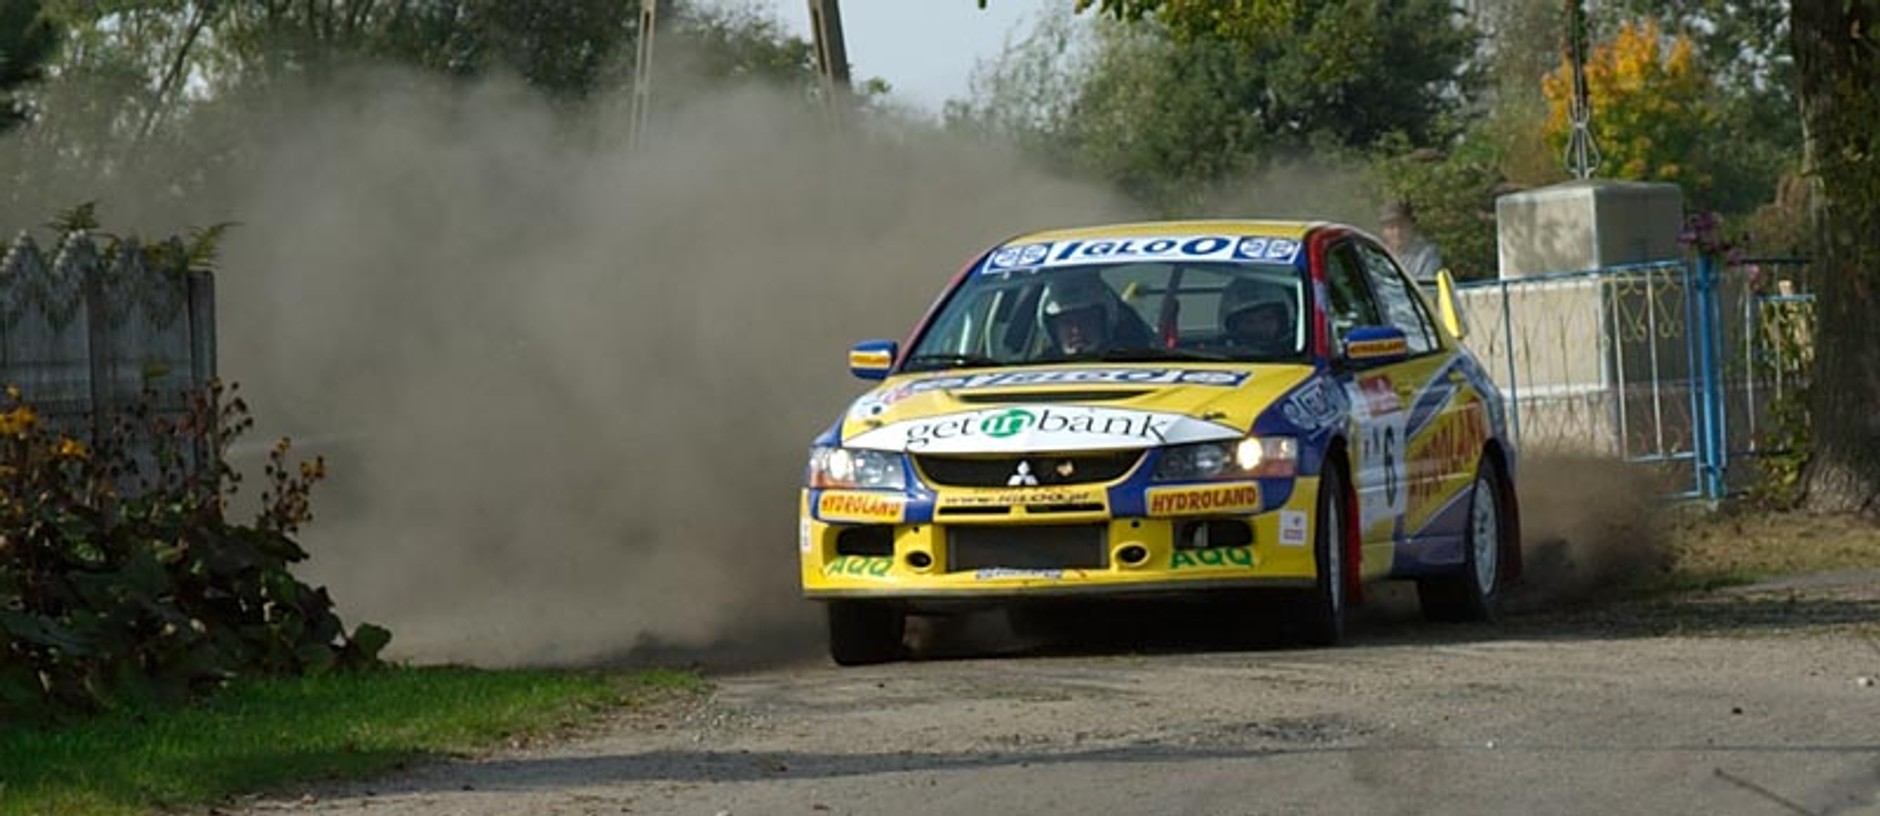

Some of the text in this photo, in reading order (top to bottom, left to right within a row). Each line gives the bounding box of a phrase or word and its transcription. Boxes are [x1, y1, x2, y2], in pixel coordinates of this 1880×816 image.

[1055, 237, 1231, 260] IGLOO
[1383, 423, 1398, 509] 6
[1151, 485, 1257, 512] HYDROLAND
[826, 555, 894, 577] AQQ
[1170, 547, 1255, 569] AQQ
